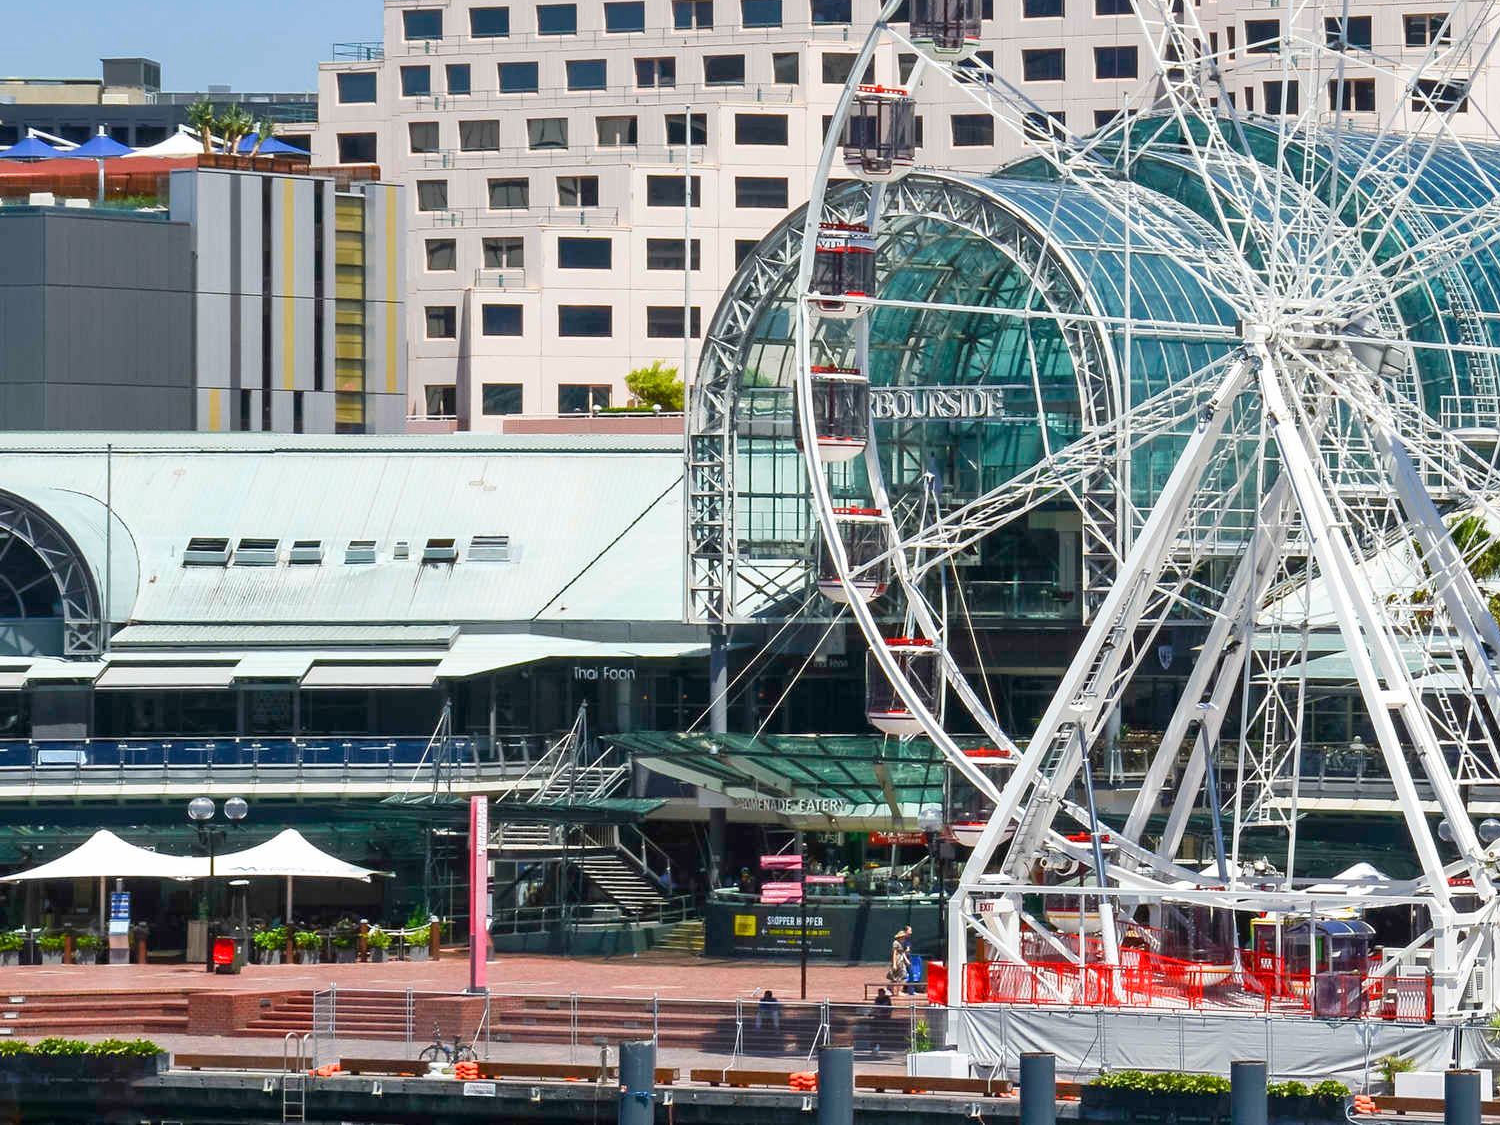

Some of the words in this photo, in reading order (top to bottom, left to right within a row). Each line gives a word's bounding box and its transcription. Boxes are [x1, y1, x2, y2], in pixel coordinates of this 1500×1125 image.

[799, 799, 847, 813] EATERY
[980, 903, 994, 911] EXIT
[796, 916, 824, 927] HPPER
